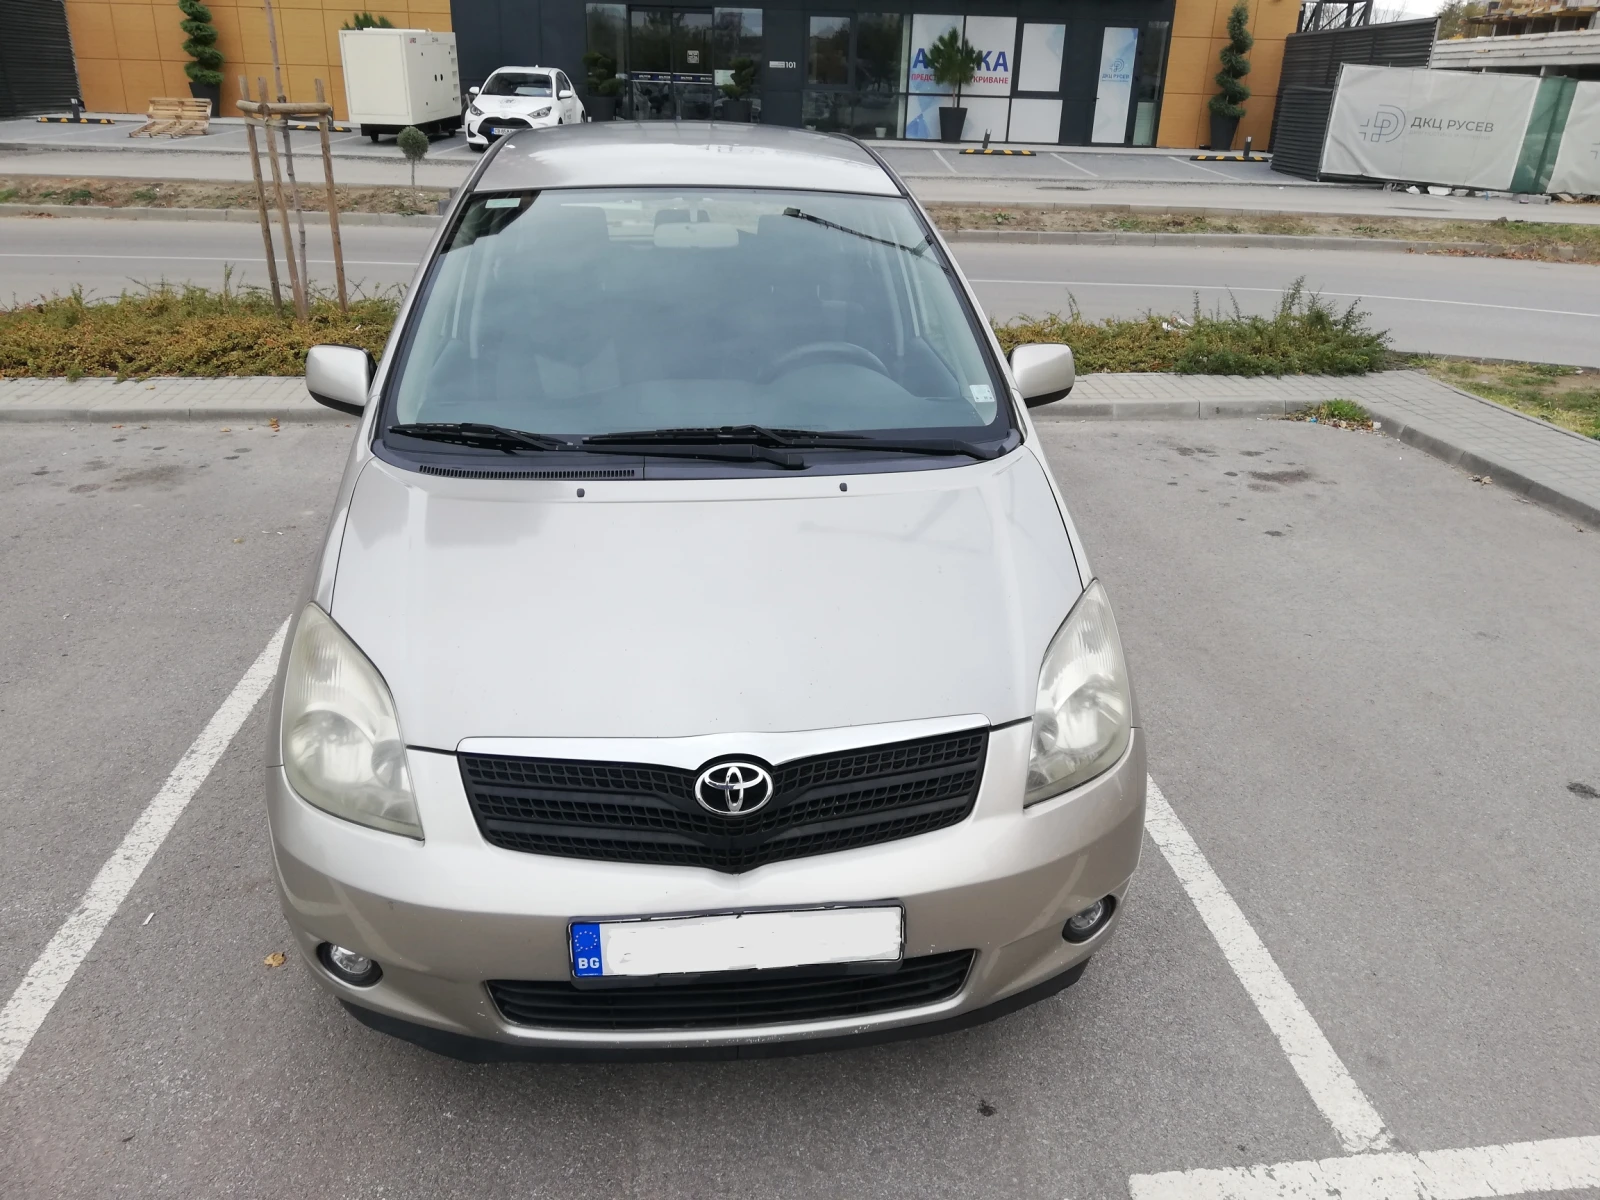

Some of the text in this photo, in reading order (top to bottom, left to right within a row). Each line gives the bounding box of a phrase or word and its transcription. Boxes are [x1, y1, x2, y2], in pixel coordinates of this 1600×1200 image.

[785, 61, 796, 69] 101
[912, 47, 1009, 72] АКА
[972, 75, 1009, 85] КРИВАНЕ
[1410, 116, 1494, 133] ДКЦ РУСЕВ
[578, 957, 600, 969] BG
